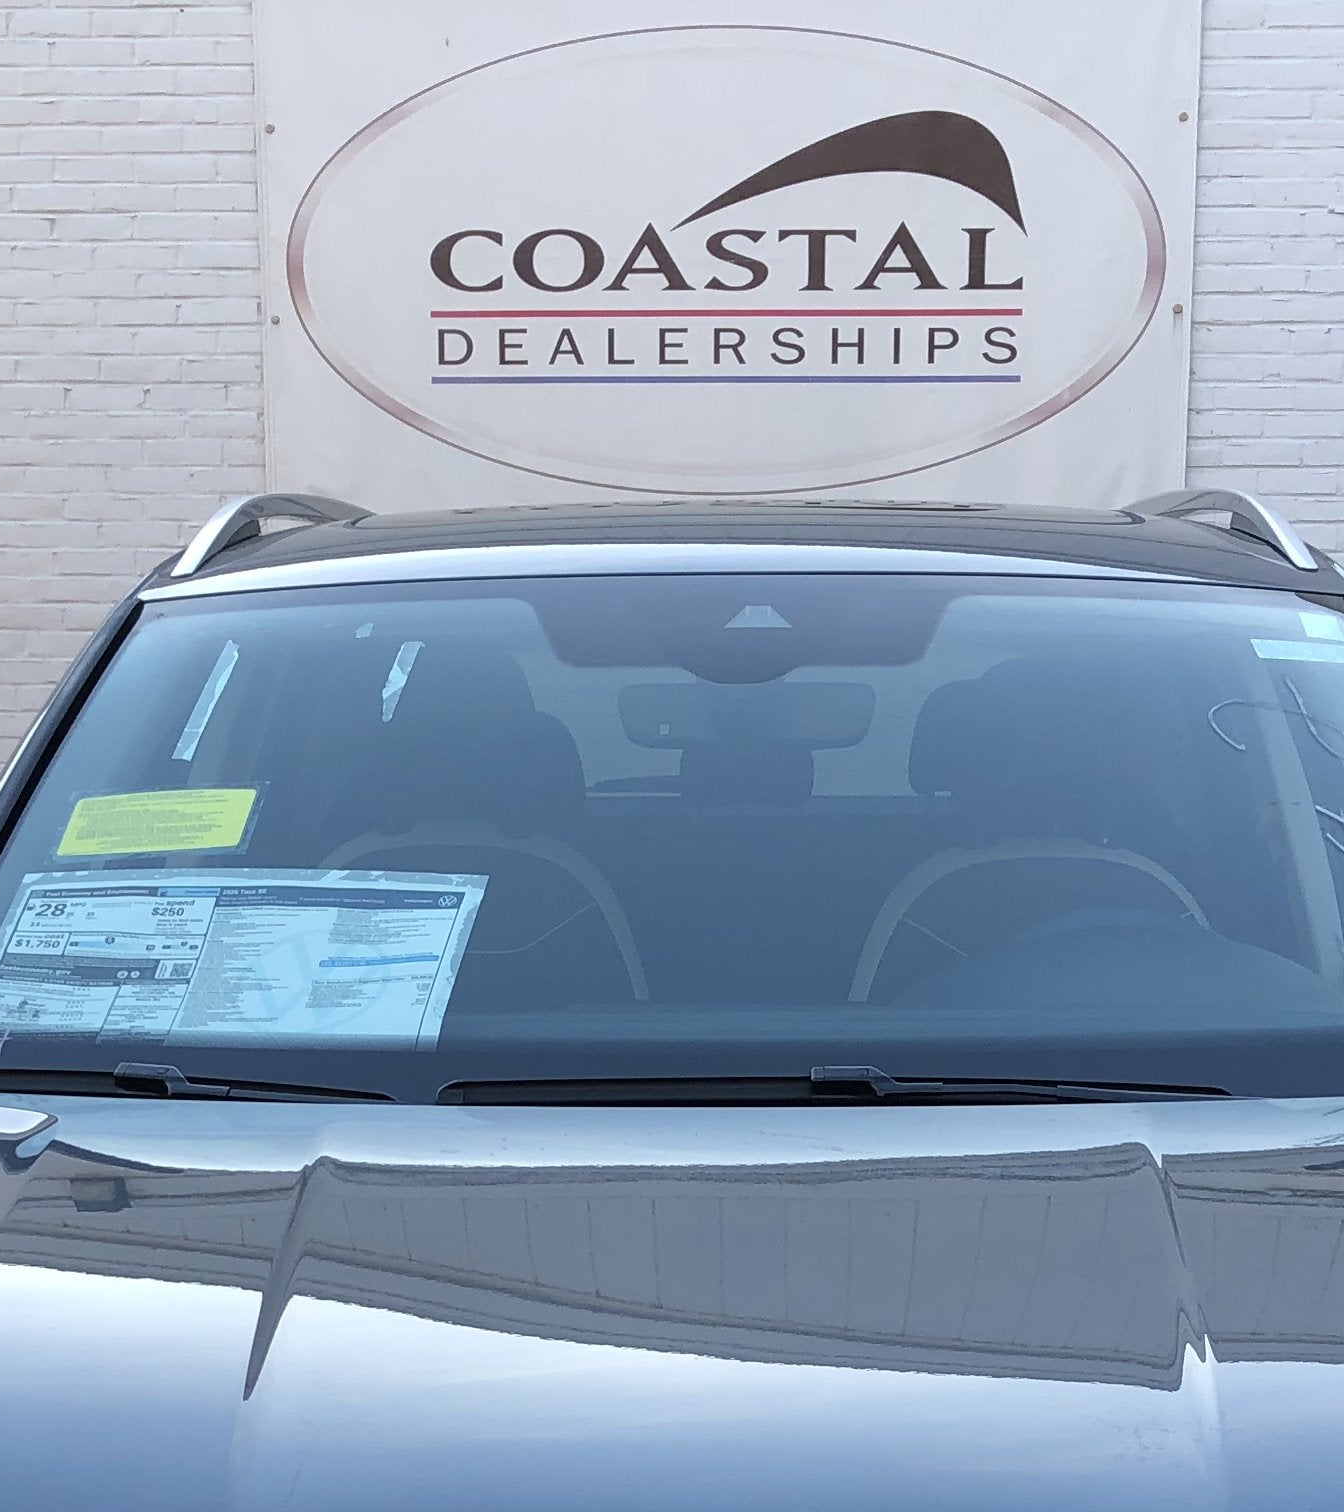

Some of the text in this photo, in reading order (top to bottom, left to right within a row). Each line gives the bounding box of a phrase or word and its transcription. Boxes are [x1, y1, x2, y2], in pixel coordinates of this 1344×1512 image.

[430, 222, 1024, 292] COASTAL
[438, 326, 1020, 366] DEALERSHIPS
[35, 903, 68, 917] 28
[151, 907, 185, 917] $250
[14, 938, 61, 949] $1,750
